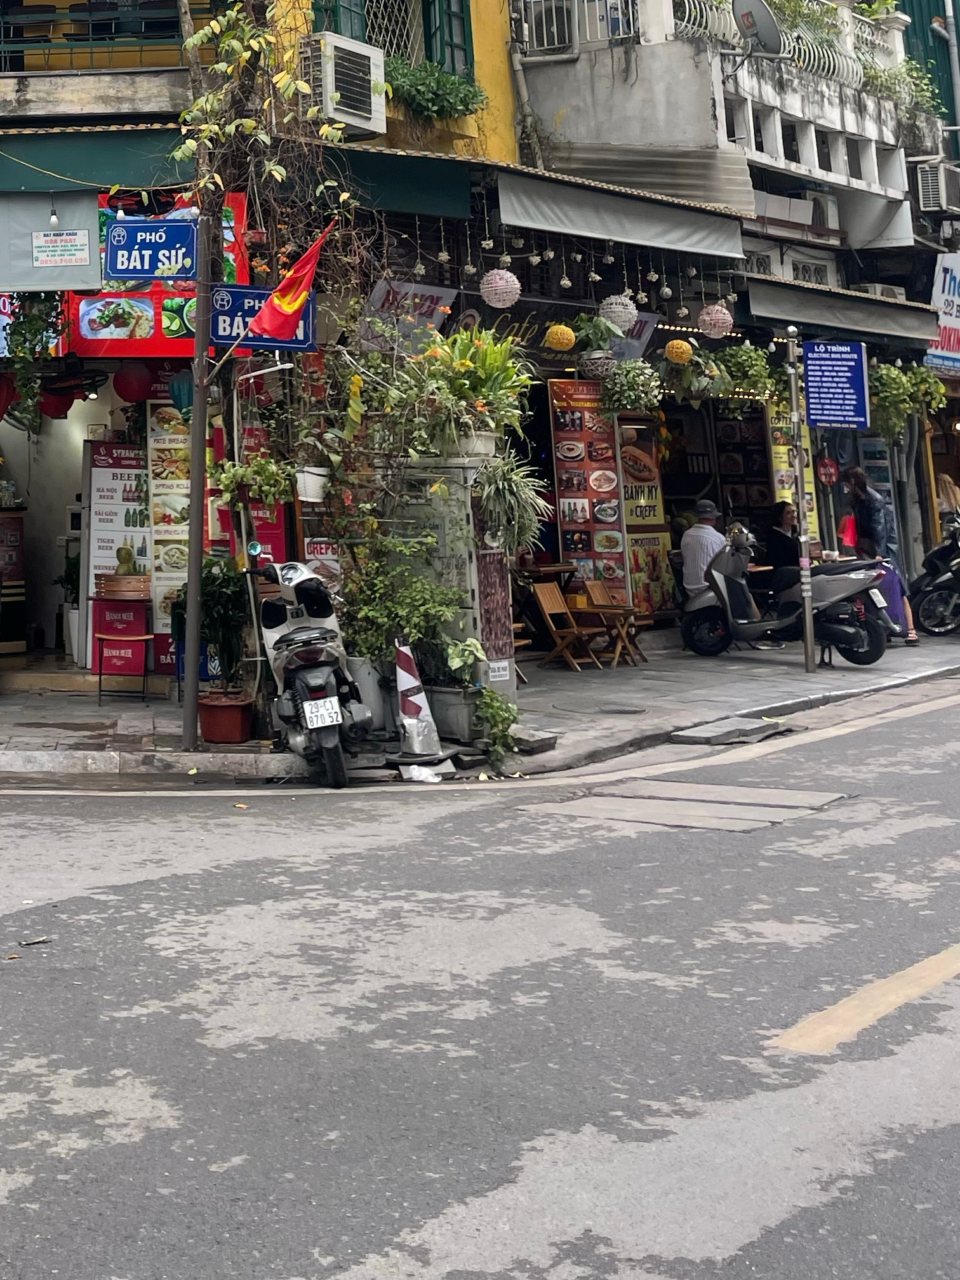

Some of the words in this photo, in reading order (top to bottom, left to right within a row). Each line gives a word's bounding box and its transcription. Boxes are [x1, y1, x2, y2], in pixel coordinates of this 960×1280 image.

[137, 227, 166, 243] PHỐ
[117, 244, 152, 270] BÁT
[158, 244, 187, 270] SỨ
[244, 299, 263, 311] PH
[814, 344, 825, 352] LỘ
[624, 482, 645, 500] BÁNH
[309, 700, 334, 715] 29-C1
